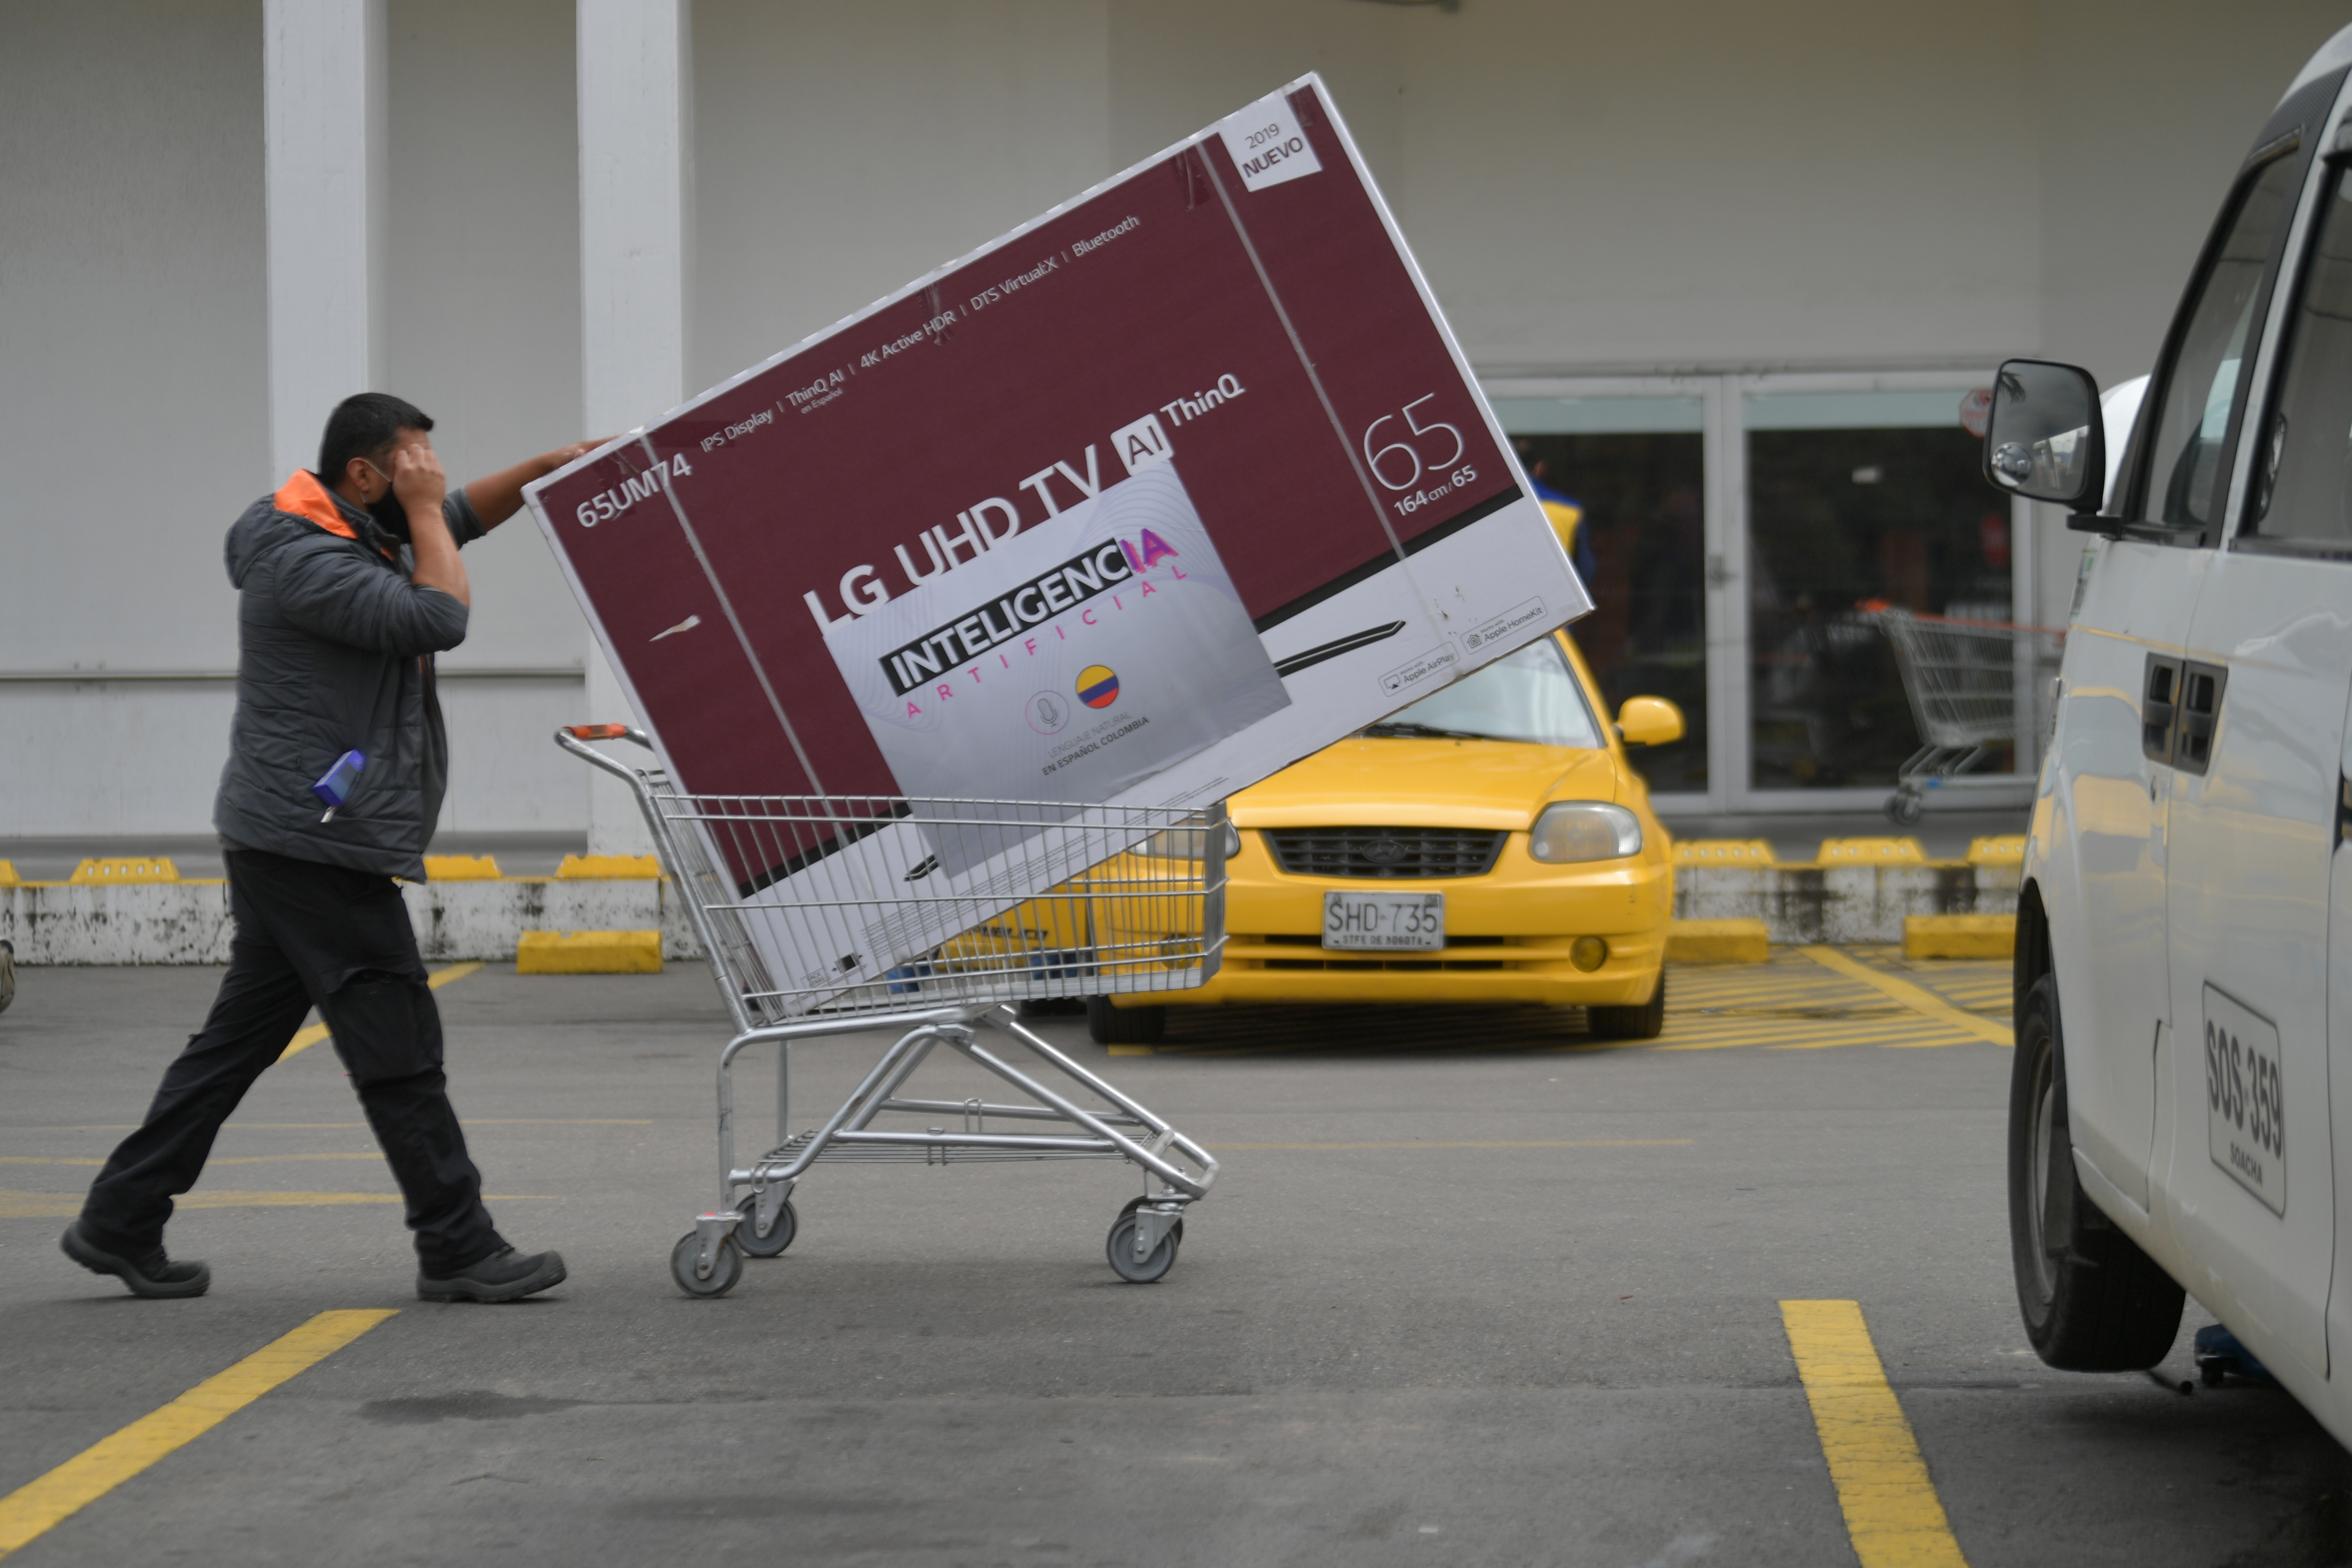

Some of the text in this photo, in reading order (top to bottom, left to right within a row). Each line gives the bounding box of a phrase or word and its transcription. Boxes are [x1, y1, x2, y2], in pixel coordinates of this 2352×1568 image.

[1241, 137, 1303, 178] NUEVO
[1244, 123, 1279, 149] 2019
[576, 454, 693, 528] 65UM74
[700, 432, 725, 452] IPS
[724, 409, 774, 440] Display
[785, 378, 829, 408] ThinQ
[829, 369, 845, 390] AI
[860, 350, 881, 369] 4K
[881, 329, 923, 358] Active
[923, 311, 957, 335] HDR
[970, 288, 1001, 310] DTS
[1072, 216, 1141, 257] Bluetooth
[800, 388, 843, 414] en Español
[1364, 392, 1464, 490] 65
[803, 373, 1245, 636] LG UHD TV AI ThinQ
[890, 528, 1178, 689] INTELIGENCIA
[1480, 619, 1504, 633] Works with
[1484, 607, 1543, 642] Apple HomeKit
[907, 565, 1186, 718] ARTIFICIAL
[1399, 661, 1424, 676] Works with
[1404, 653, 1455, 684] Apple AirPlay
[1042, 717, 1149, 776] EN ESPAÑOL COLOMBIA
[1048, 712, 1130, 758] LENGUAJE NATURAL
[1328, 902, 1438, 933] SHD 735
[1370, 935, 1382, 945] DE
[2206, 1019, 2281, 1160] SOS 359
[2230, 1141, 2262, 1188] SOACHA
